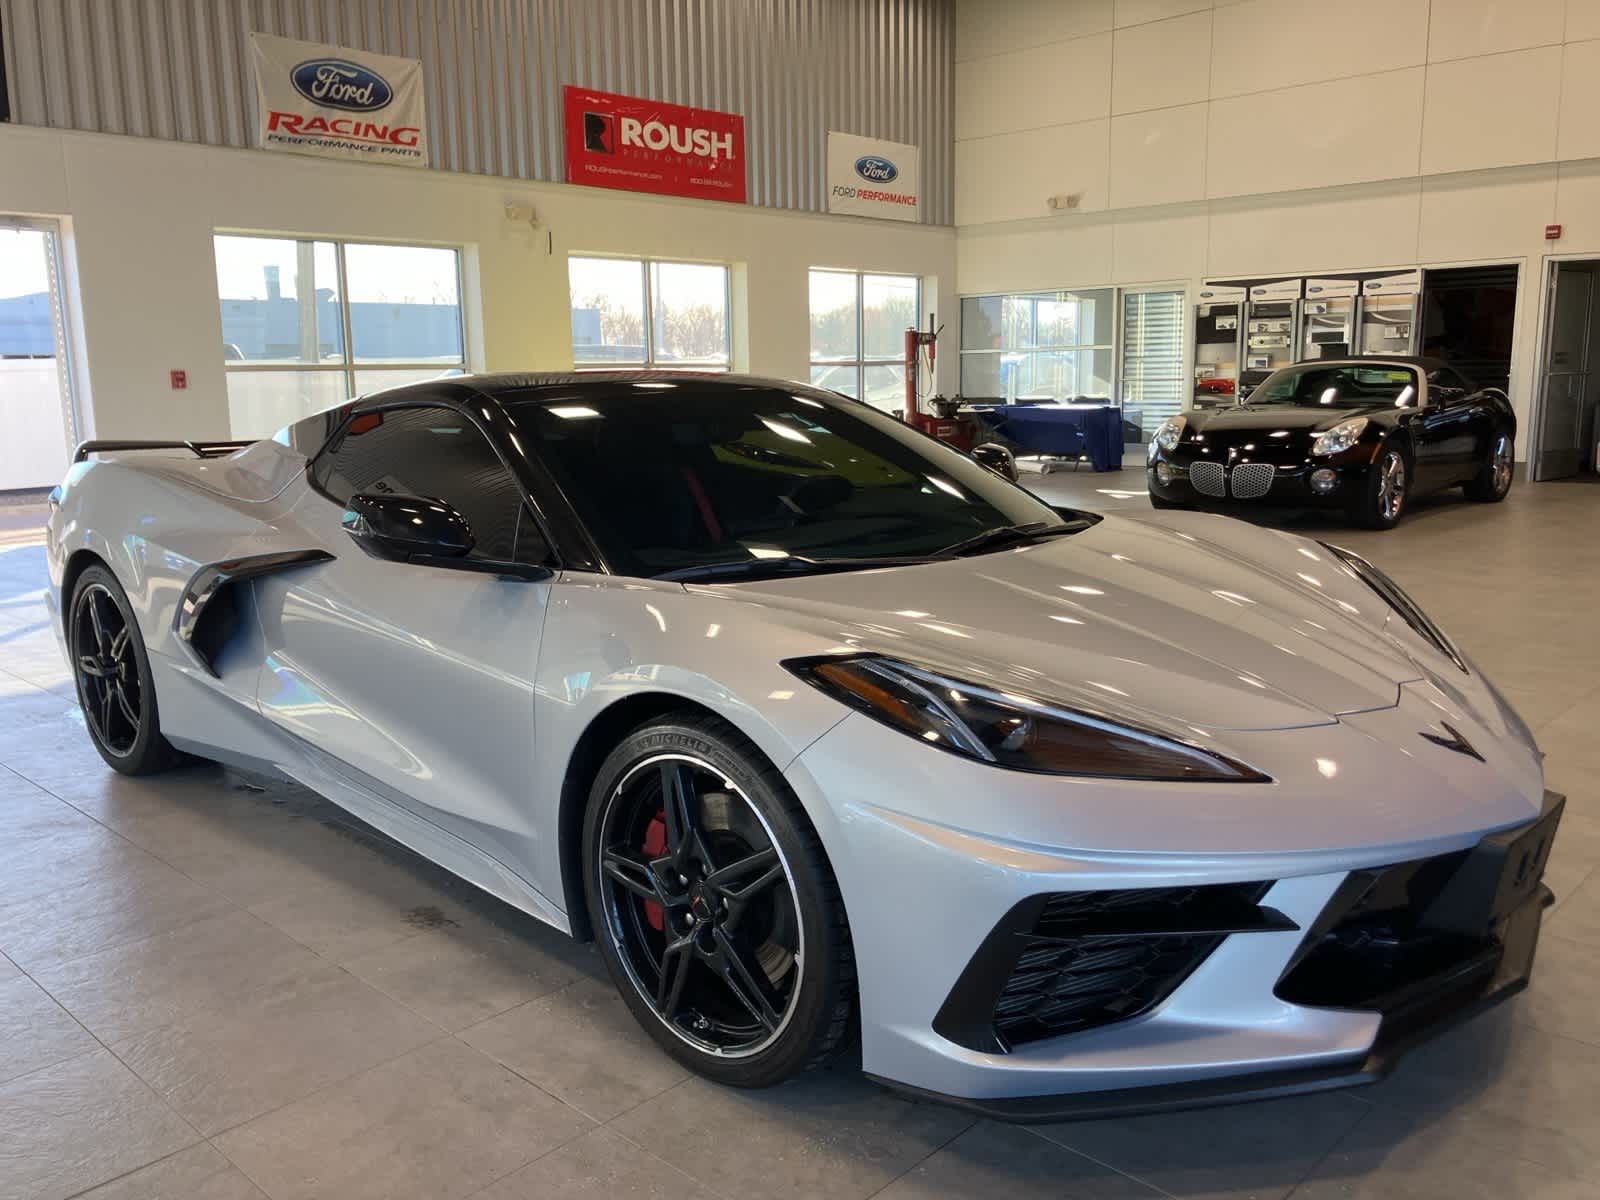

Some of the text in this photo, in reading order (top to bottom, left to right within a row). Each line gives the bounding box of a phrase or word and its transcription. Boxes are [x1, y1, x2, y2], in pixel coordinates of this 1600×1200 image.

[311, 65, 374, 105] Ford
[267, 111, 421, 147] RACING
[620, 117, 733, 160] ROUSH
[267, 134, 422, 158] PERFORMANCE PARTS
[863, 159, 890, 179] Ford
[832, 185, 917, 206] FORD PERFORMANCE
